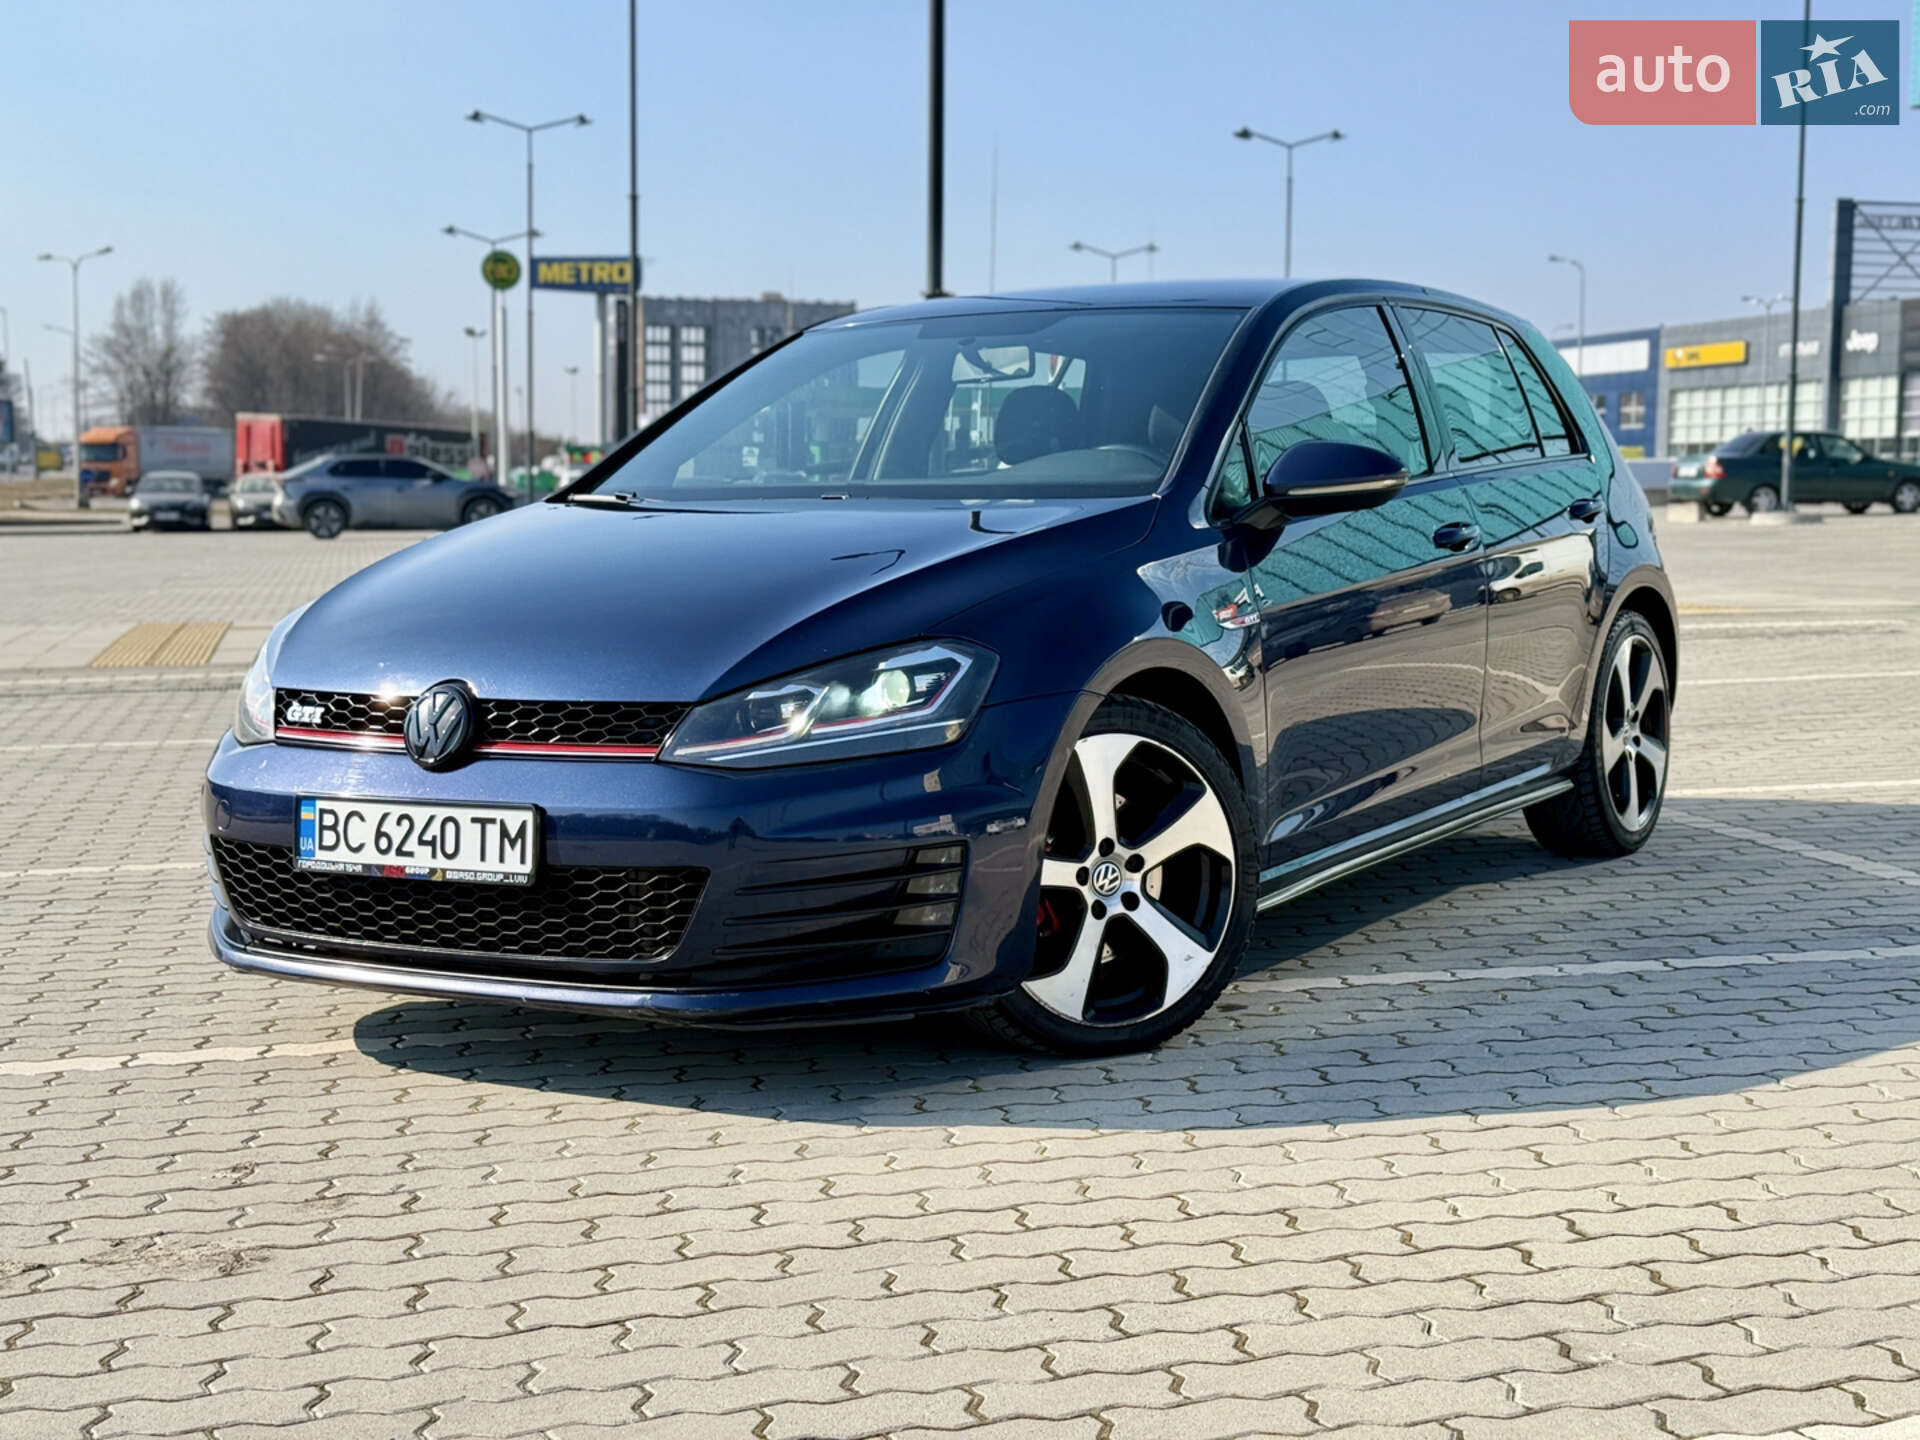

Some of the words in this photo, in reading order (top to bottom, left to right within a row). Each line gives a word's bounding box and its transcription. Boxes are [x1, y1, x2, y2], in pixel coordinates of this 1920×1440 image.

[537, 260, 633, 285] METRO
[286, 701, 325, 723] GTI
[300, 837, 314, 851] UA
[318, 808, 366, 853] BC
[374, 811, 461, 860] 6240
[470, 817, 528, 865] TM
